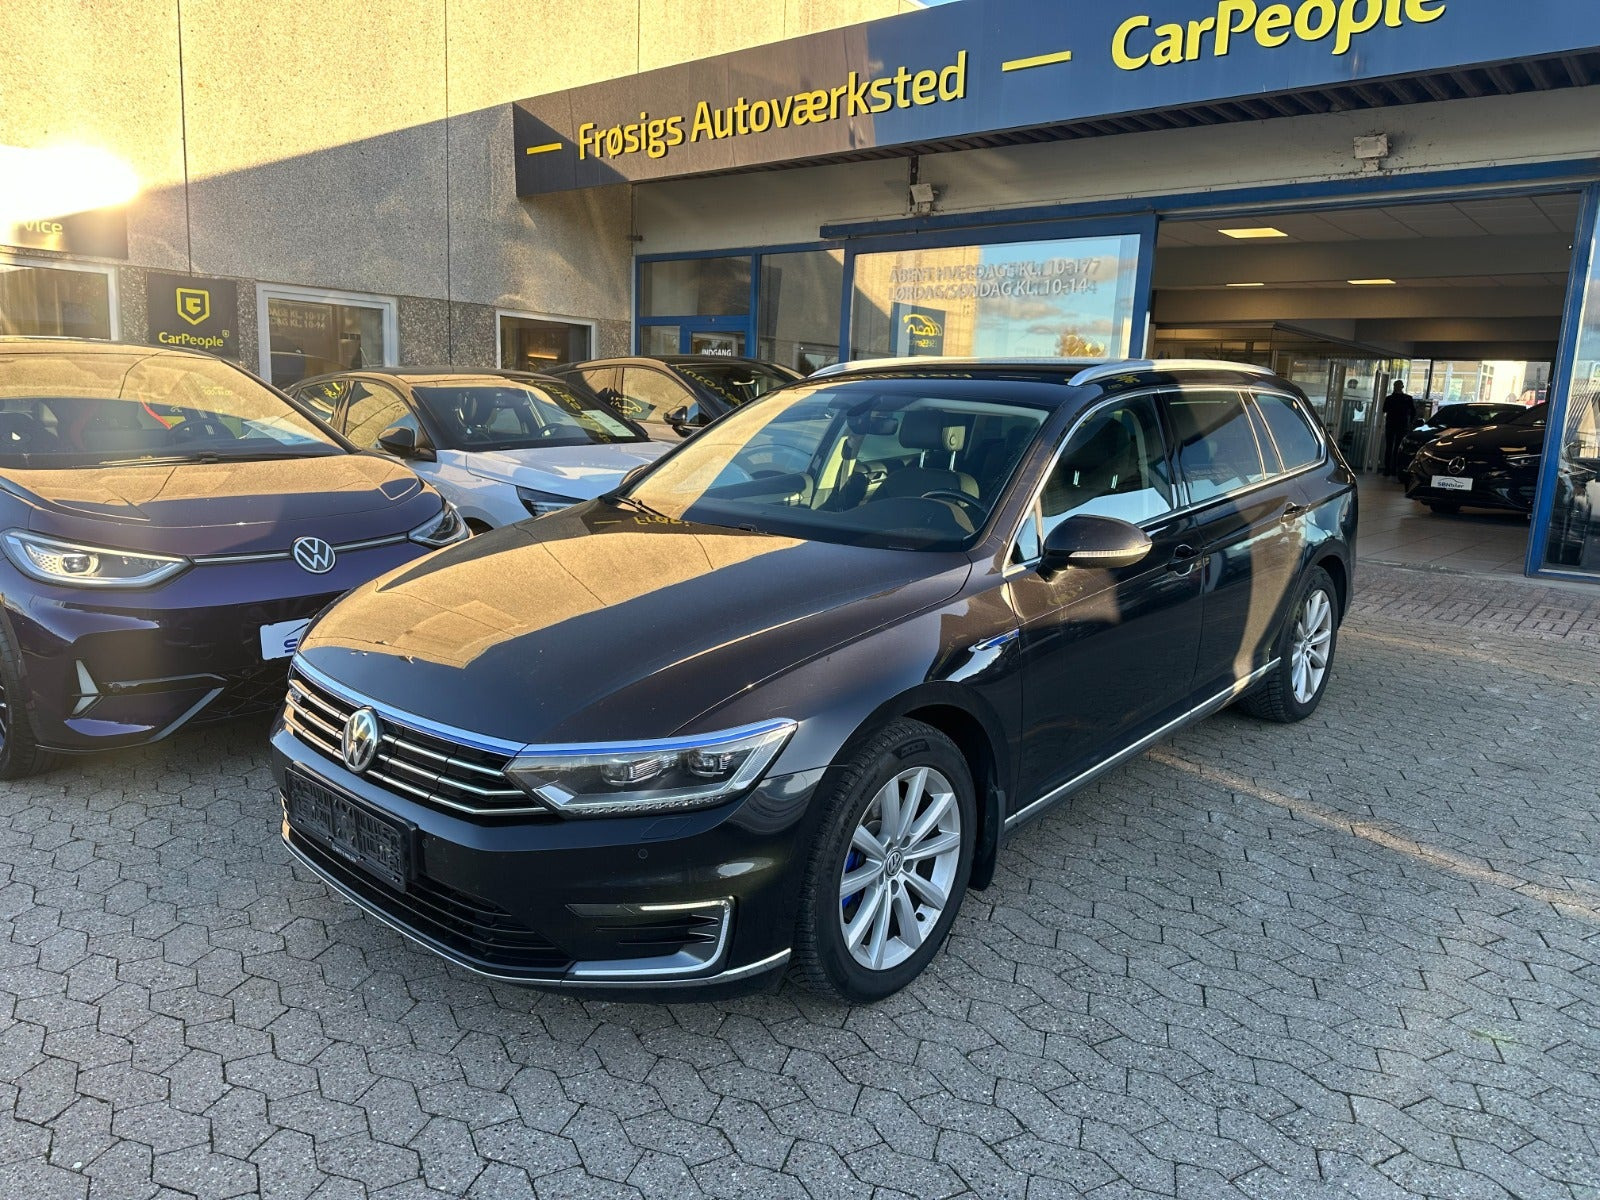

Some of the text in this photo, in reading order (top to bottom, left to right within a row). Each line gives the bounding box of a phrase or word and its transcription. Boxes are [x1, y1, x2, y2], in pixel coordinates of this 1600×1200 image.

[579, 51, 966, 160] Frøsigs Autoværksted
[158, 331, 224, 349] CarPeople
